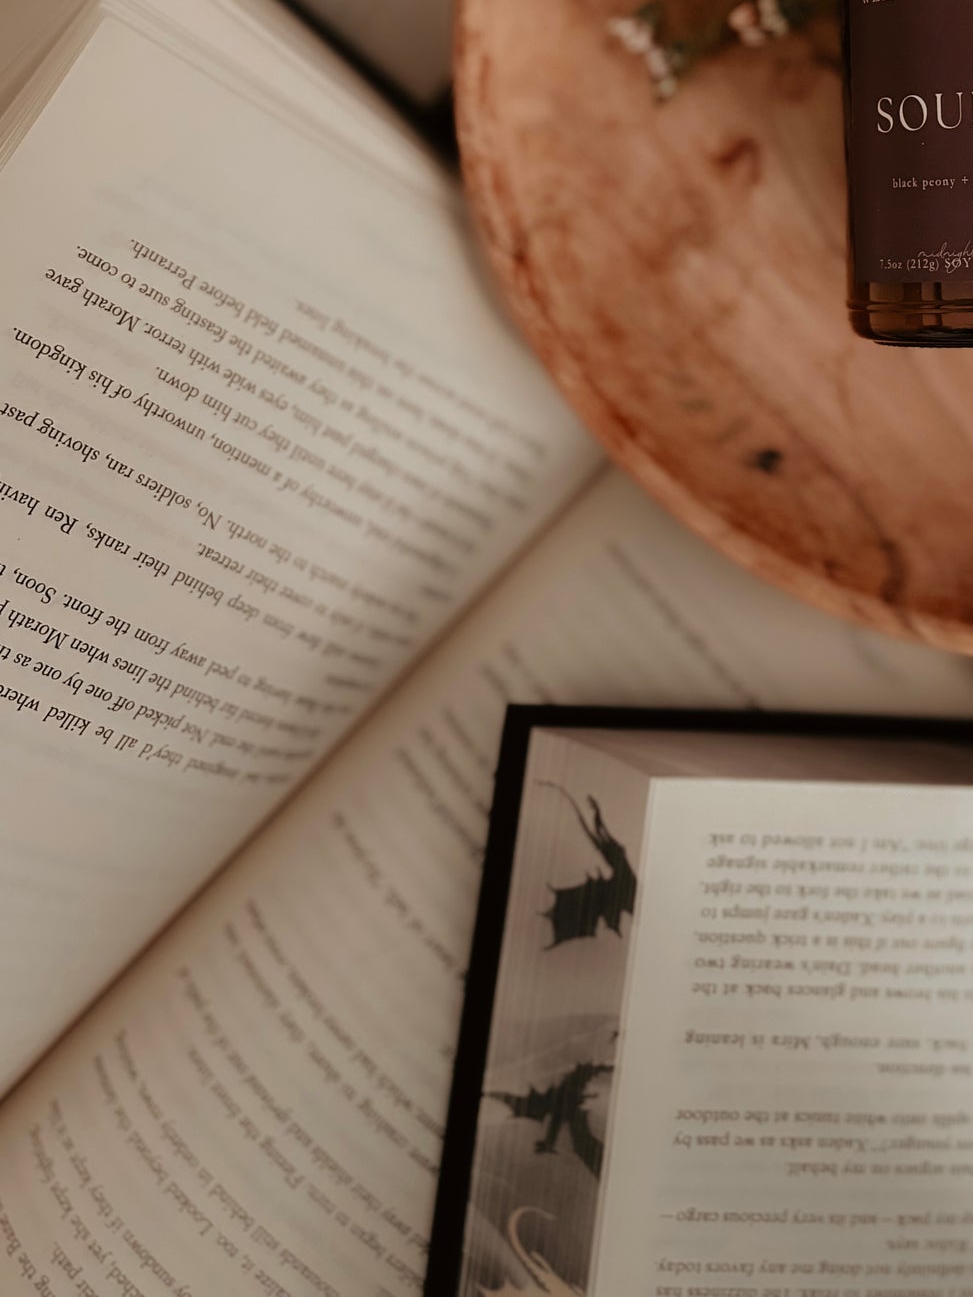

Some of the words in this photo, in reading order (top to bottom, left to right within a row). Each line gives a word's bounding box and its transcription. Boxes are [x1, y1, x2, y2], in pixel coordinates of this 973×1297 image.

[892, 177, 918, 189] black
[922, 177, 956, 190] peony
[76, 246, 118, 276] come.
[131, 239, 197, 290] Perranth.
[906, 257, 940, 272] (212g)
[944, 257, 971, 268] SOY
[45, 268, 84, 293] gave
[120, 273, 136, 288] to
[138, 283, 170, 306] sure
[198, 281, 245, 318] before
[82, 288, 140, 332] Morath
[170, 298, 227, 342] feasting
[243, 308, 279, 336] field
[143, 322, 186, 354] terror.
[228, 334, 253, 356] the
[13, 327, 86, 380] kingdom.
[188, 348, 220, 374] with
[88, 370, 114, 394] his
[108, 384, 132, 399] of
[156, 366, 199, 401] down.
[222, 368, 256, 394] wide
[201, 393, 232, 422] him
[258, 388, 288, 411] eyes
[1, 402, 40, 427] past
[132, 392, 205, 440] unworthy
[232, 411, 258, 431] cut
[36, 418, 100, 462] shoving
[257, 424, 291, 452] they
[105, 453, 134, 478] ran,
[210, 433, 271, 476] mention,
[135, 473, 192, 508] soldiers
[276, 477, 300, 492] of
[44, 505, 78, 534] Ren
[196, 501, 222, 530] No,
[86, 522, 130, 555] ranks,
[227, 520, 268, 548] north.
[132, 551, 170, 577] their
[197, 542, 244, 574] retreat.
[13, 568, 57, 604] Soon,
[170, 570, 224, 606] behind
[243, 569, 278, 594] their
[63, 594, 104, 625] front.
[8, 609, 69, 649] Morath
[105, 615, 131, 636] the
[70, 638, 109, 663] when
[134, 628, 170, 655] from
[169, 642, 206, 666] away
[13, 653, 32, 667] as
[32, 661, 62, 680] one
[112, 657, 148, 684] lines
[204, 661, 239, 680] peel
[62, 671, 84, 695] by
[84, 684, 113, 701] one
[147, 672, 172, 692] the
[107, 695, 135, 712] off
[169, 683, 220, 712] behind
[42, 706, 91, 736] killed
[132, 705, 185, 730] picked
[94, 725, 114, 745] be
[114, 734, 138, 751] all
[137, 743, 183, 766] they'd
